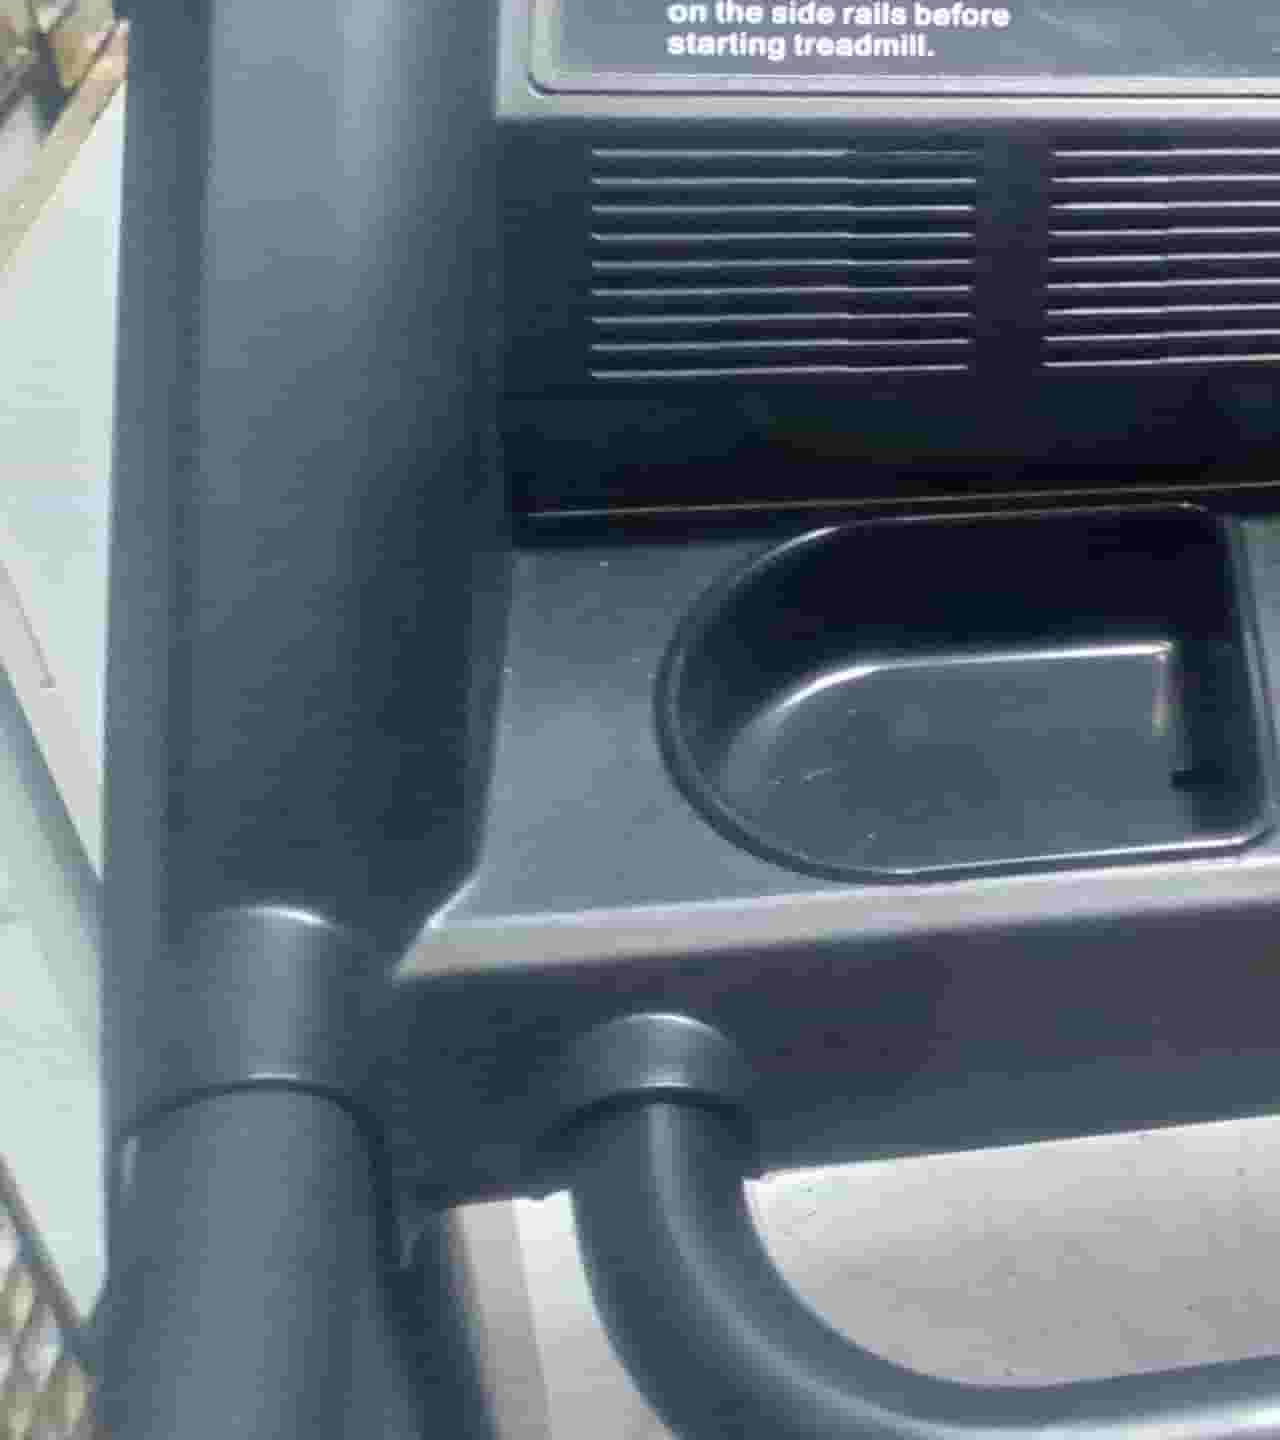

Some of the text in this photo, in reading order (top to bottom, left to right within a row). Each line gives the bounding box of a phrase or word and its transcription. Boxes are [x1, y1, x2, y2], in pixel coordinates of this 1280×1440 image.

[667, 1, 1011, 28] on the side rails before
[667, 33, 935, 61] starting treadmill.
